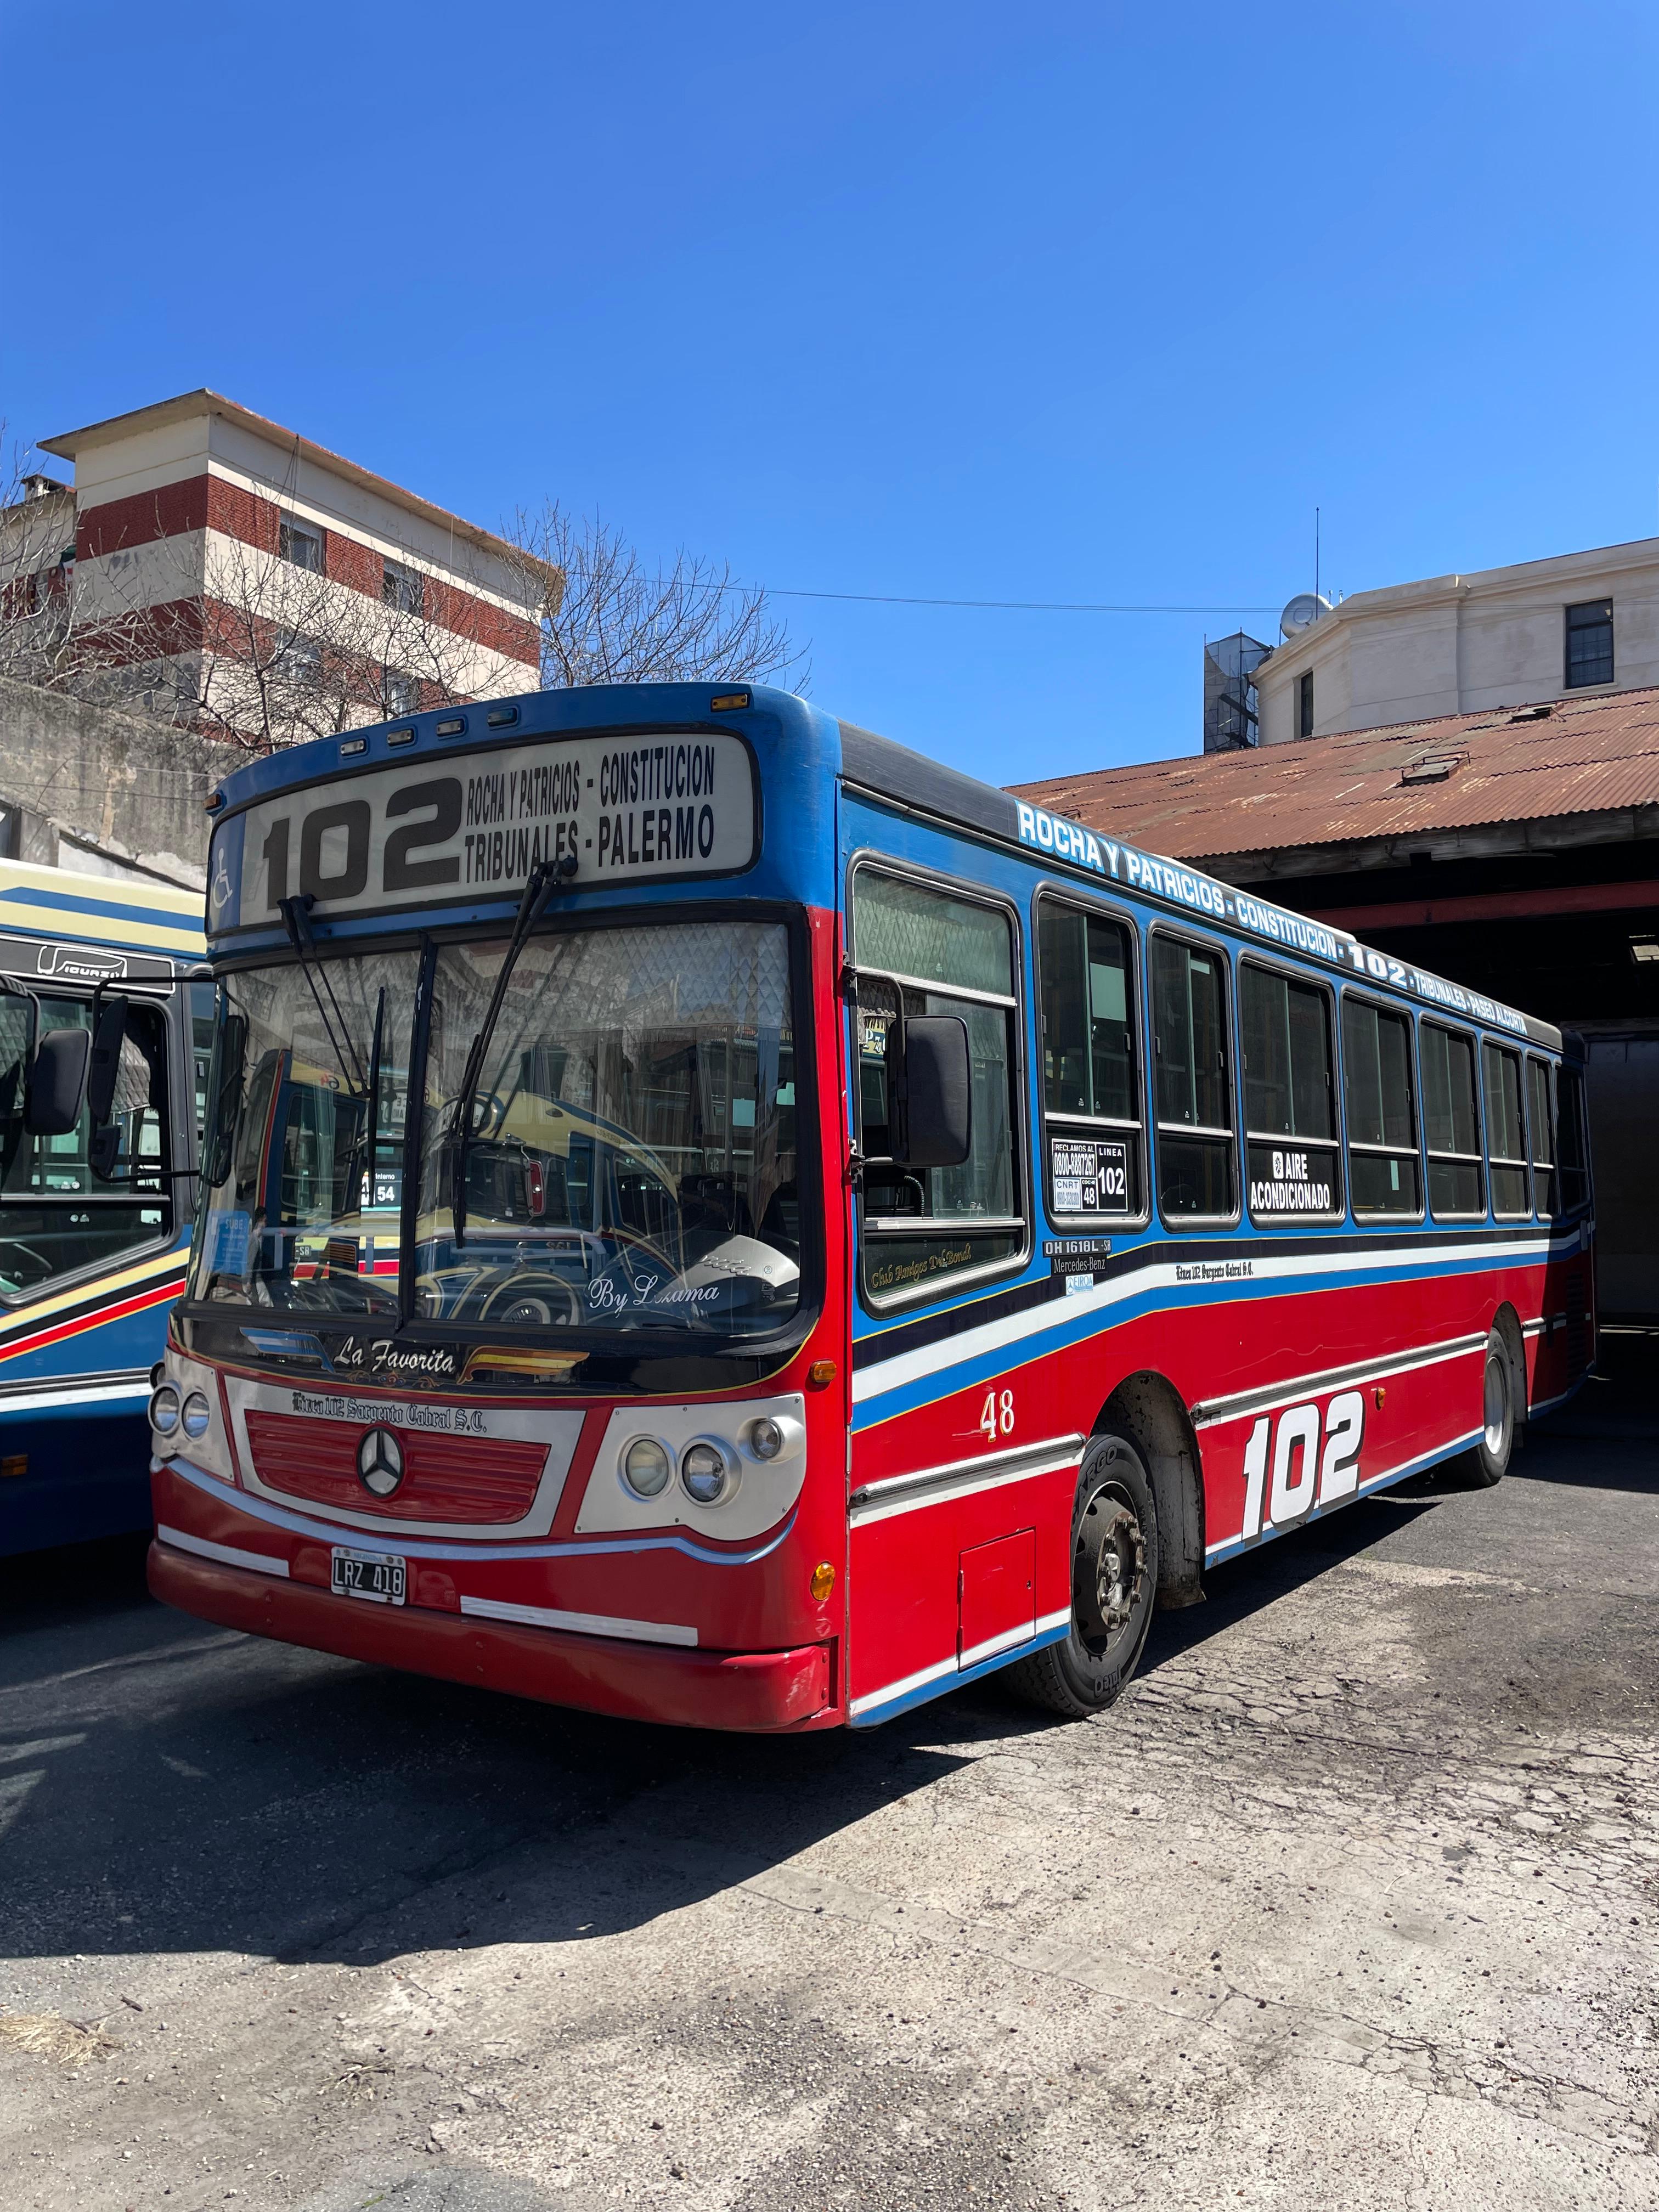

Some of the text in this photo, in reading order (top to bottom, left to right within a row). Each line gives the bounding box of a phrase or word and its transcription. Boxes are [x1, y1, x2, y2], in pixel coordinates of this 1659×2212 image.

[467, 774, 504, 826] ROCHA
[510, 771, 517, 820] Y
[520, 760, 580, 819] PATRICIOS
[601, 744, 714, 807] CONSTITUCION
[263, 777, 462, 910] 102
[465, 820, 578, 883] TRIBUNALES
[599, 804, 714, 867] PALERMO
[1015, 799, 1103, 872] ROCHA
[1098, 837, 1119, 878] Y
[1121, 846, 1226, 919] PATRICIOS
[1235, 894, 1338, 963] CONSTITUCION
[1347, 941, 1408, 990] 102
[1413, 969, 1468, 1012] TRIBUNALES
[1468, 992, 1497, 1023] PASEO
[1495, 1004, 1528, 1036] ALCORTA
[1055, 1144, 1086, 1152] RECLAMOS
[1099, 1147, 1122, 1157] LINEA
[1054, 1152, 1095, 1176] 0800-8887267
[1285, 1153, 1308, 1180] AIRE
[377, 1186, 395, 1201] 54
[1057, 1180, 1079, 1189] CNRT
[1098, 1167, 1125, 1195] 102
[1084, 1187, 1095, 1205] 48
[1250, 1181, 1330, 1210] ACONDICIONADO
[1045, 1242, 1063, 1255] OH
[1065, 1240, 1099, 1254] 1618L
[871, 1264, 893, 1288] Club
[895, 1261, 928, 1282] Amigos
[1053, 1256, 1106, 1273] Mercedes-Benz
[1192, 1265, 1201, 1280] 102
[1201, 1264, 1224, 1281] Sargento
[1226, 1262, 1242, 1277] Cabral
[1074, 1275, 1093, 1287] EIROA
[588, 1278, 628, 1318] By
[334, 1335, 456, 1373] La Favorita
[325, 1396, 345, 1418] 102
[347, 1398, 403, 1424] Sargento
[406, 1403, 450, 1429] Cabral
[454, 1408, 487, 1433] S.C.
[980, 1389, 1014, 1443] 48
[1242, 1390, 1365, 1545] 102
[335, 1559, 402, 1595] LRZ 418
